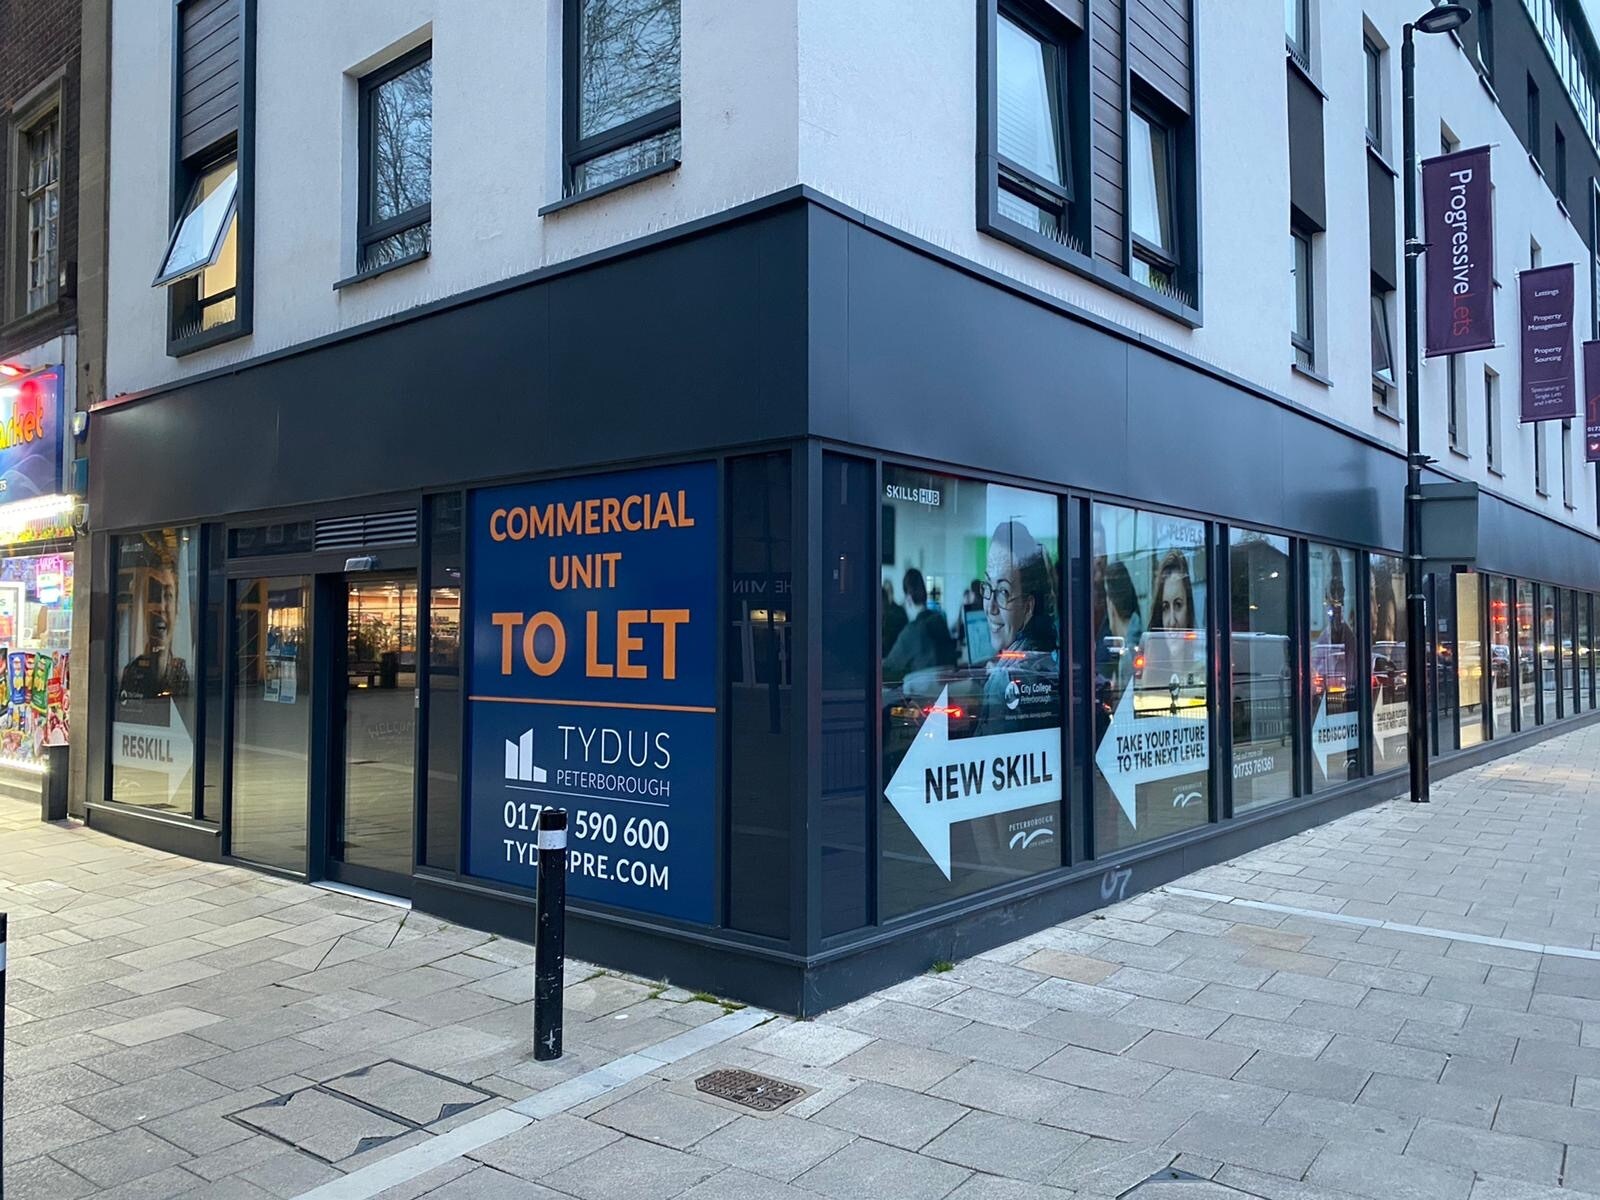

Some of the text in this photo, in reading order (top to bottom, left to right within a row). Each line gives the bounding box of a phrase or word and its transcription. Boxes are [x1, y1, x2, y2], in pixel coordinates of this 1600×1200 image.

[1534, 288, 1560, 297] Lettings
[1528, 321, 1568, 331] Management
[1533, 313, 1562, 322] Property
[1534, 346, 1562, 355] Property
[1534, 355, 1562, 363] Sourcing
[886, 484, 918, 501] SKILLS
[490, 490, 695, 542] COMMERCIAL
[549, 552, 622, 590] UNIT
[492, 609, 690, 680] TO LET
[1020, 682, 1052, 695] City College
[557, 726, 671, 770] TYDUS
[1116, 725, 1205, 754] TAKE YOUR FUTURE
[1318, 723, 1358, 744] REDISCOVER
[122, 735, 173, 762] RESKILL
[1116, 742, 1206, 773] TO THE NEXT LEVEL
[556, 769, 670, 798] PETERBOROUGH
[925, 751, 1053, 804] NEW SKILL
[504, 800, 670, 852] 017 590 600
[504, 839, 670, 892] TYDPRE.COM
